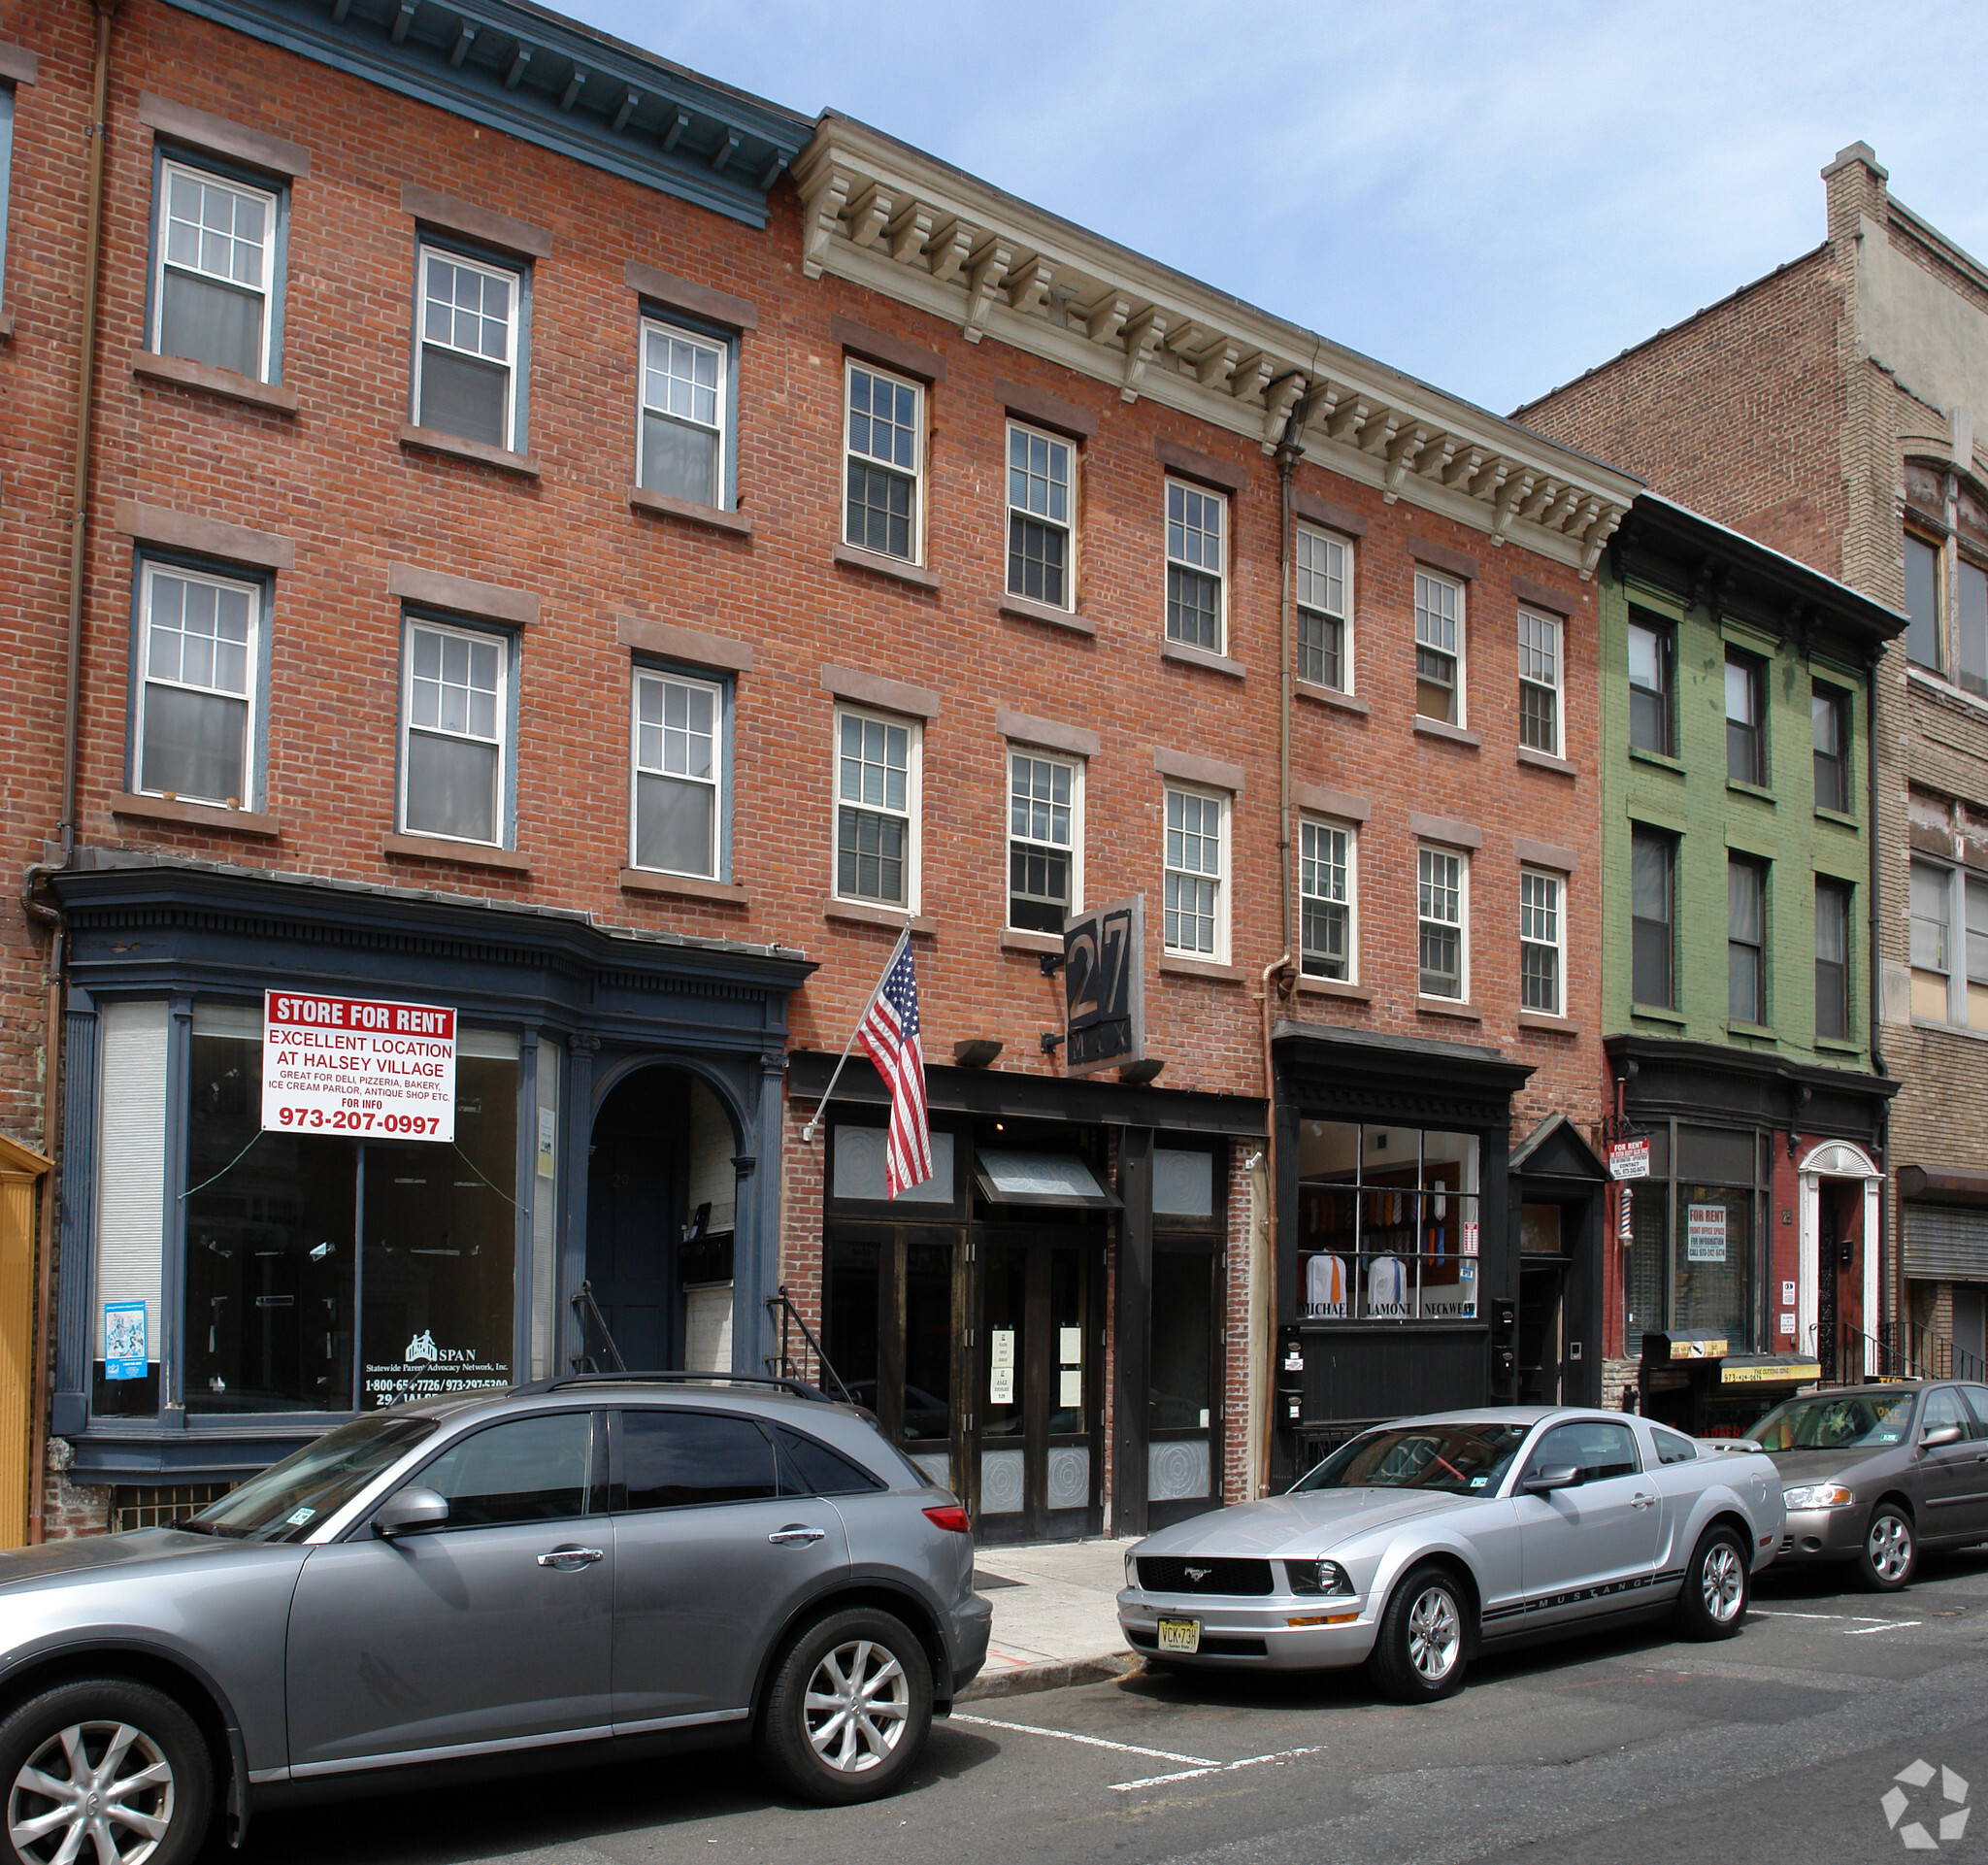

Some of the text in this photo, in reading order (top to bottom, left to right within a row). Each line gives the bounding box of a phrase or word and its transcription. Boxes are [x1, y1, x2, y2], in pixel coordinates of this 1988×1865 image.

[1067, 916, 1129, 1021] 27
[277, 997, 447, 1035] STORE FOR RENT
[269, 1029, 452, 1059] EXCELLENT LOCATION
[277, 1050, 444, 1078] AT HALSEY VILLAGE
[268, 1080, 450, 1102] ICE CREAM PARLOR, ANTIQUE SHOP ETC.
[280, 1070, 441, 1091] GREAT FOR DELI, PIZZERIA, BAKERY,
[342, 1097, 383, 1110] FOR INFO
[279, 1107, 441, 1135] 973-207-0997
[1614, 1141, 1643, 1152] FOR RENT
[1689, 1209, 1724, 1223] FOR RENT
[1300, 1303, 1475, 1315] MICHAEL LAMONT NECKWEAR
[439, 1349, 476, 1362] SPAN
[366, 1363, 402, 1373] Statewide
[427, 1362, 461, 1373] Advocacy
[462, 1362, 494, 1372] Network,
[495, 1362, 509, 1371] Inc.
[377, 1393, 393, 1406] 29
[1539, 1579, 1642, 1609] MUSTANG
